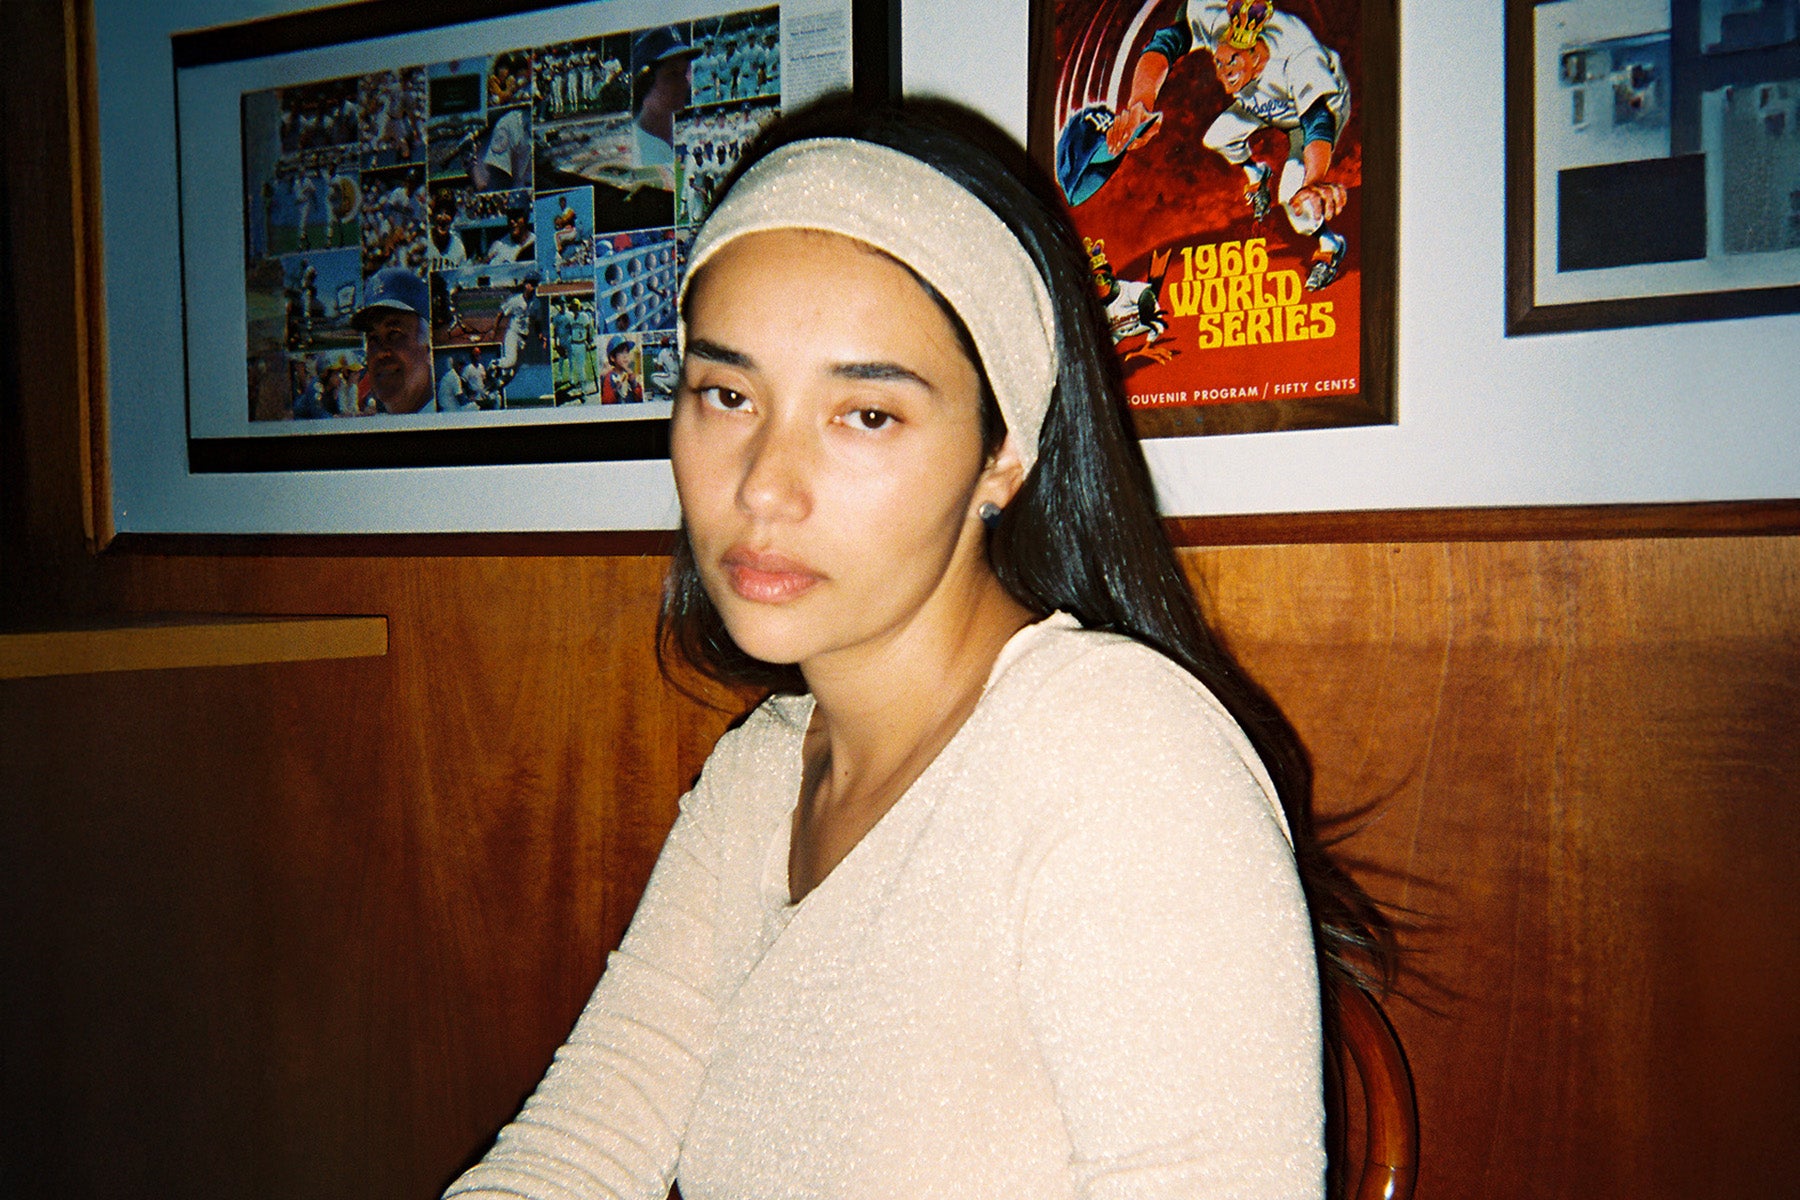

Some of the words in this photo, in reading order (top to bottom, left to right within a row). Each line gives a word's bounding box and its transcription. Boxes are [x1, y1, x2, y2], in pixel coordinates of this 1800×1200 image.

[1180, 237, 1269, 281] 1966
[1168, 269, 1302, 317] WORLD
[1198, 301, 1336, 349] SERIES
[1194, 386, 1258, 401] PROGRAM
[1274, 382, 1308, 395] FIFTY
[1315, 378, 1356, 391] CENTS
